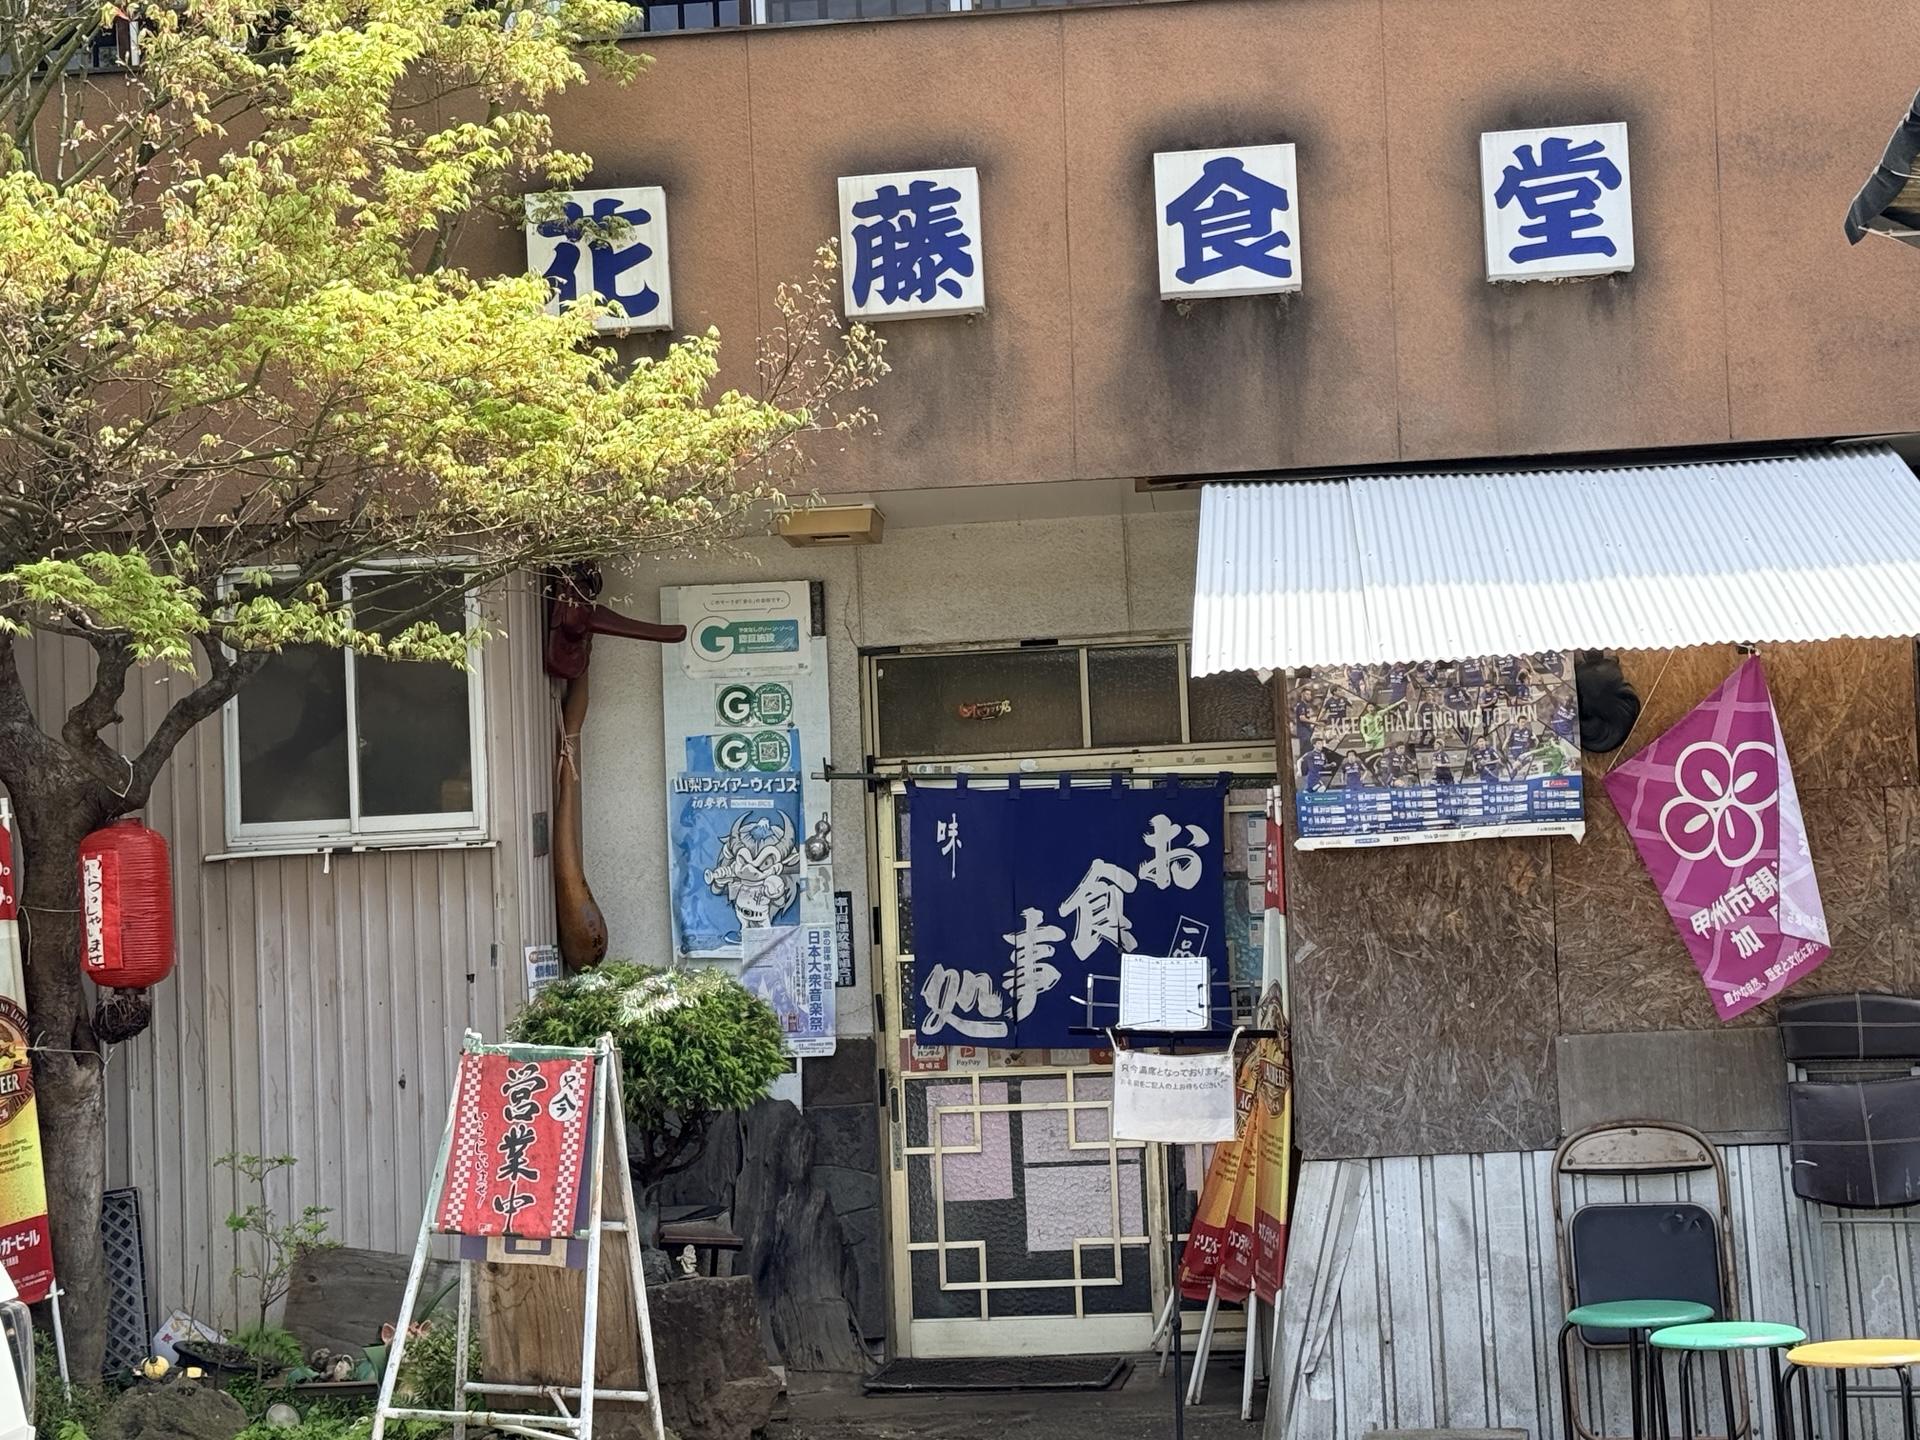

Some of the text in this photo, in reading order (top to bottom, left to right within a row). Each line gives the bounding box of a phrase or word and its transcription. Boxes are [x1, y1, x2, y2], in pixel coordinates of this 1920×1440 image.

[1375, 708, 1479, 732] CHALLENGING
[674, 776, 800, 793] 山梨ファイアーウィンズ
[936, 813, 962, 879] 味
[84, 859, 105, 966] いらっしゃいませ
[921, 814, 1210, 1038] お食事処
[1690, 861, 1778, 939] 甲州市観
[808, 931, 823, 1031] 日本大衆音楽祭
[552, 1074, 577, 1119] 只今
[493, 1062, 547, 1234] 営業中
